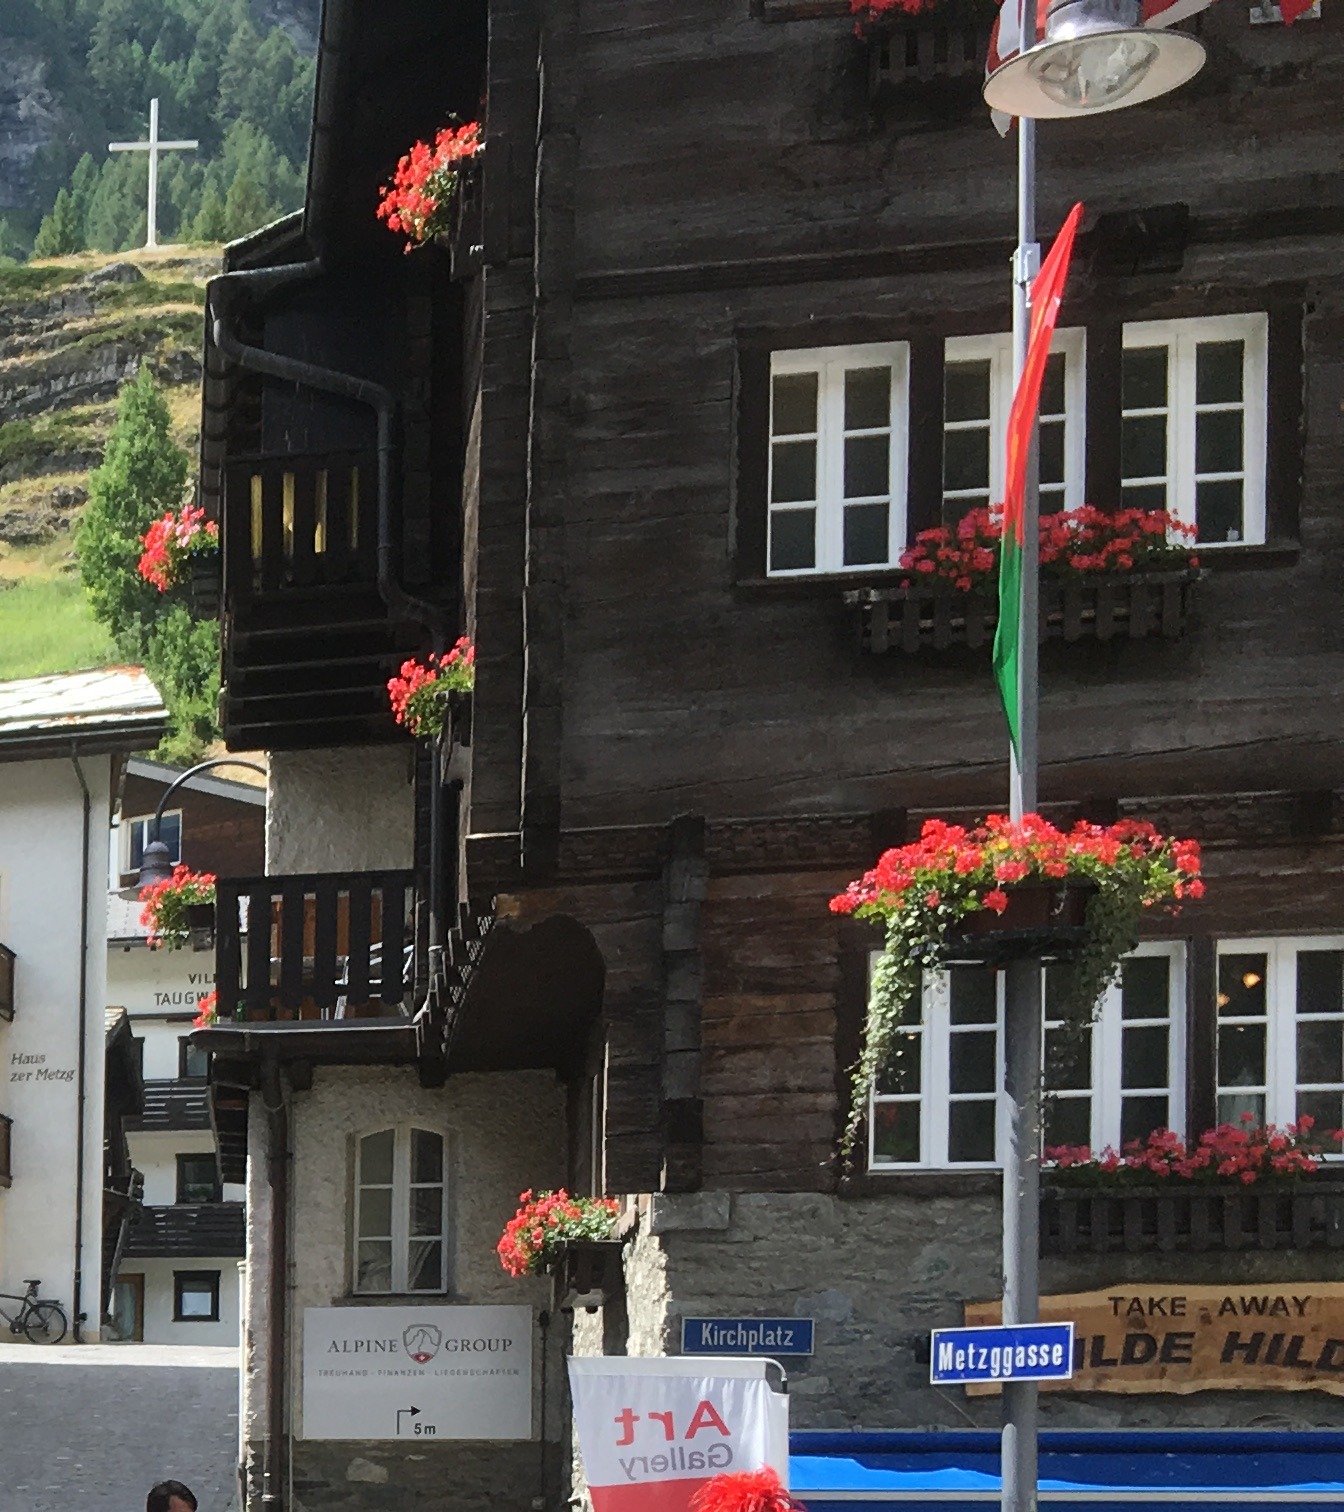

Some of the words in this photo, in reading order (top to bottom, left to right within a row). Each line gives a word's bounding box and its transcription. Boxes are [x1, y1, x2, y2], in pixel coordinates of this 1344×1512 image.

[188, 973, 217, 985] VIL
[11, 1052, 47, 1065] Haus
[10, 1071, 33, 1083] zer
[35, 1068, 76, 1083] Metzg
[1108, 1296, 1187, 1317] TAKE
[1218, 1295, 1312, 1317] AWAY
[701, 1322, 794, 1352] Kirchplatz
[327, 1339, 399, 1353] ALPINE
[445, 1338, 512, 1353] GROUP
[1072, 1331, 1197, 1370] ILDE
[938, 1341, 1064, 1377] Metzggasse
[318, 1369, 368, 1377] TREUHAND
[377, 1368, 425, 1377] FINANZEN
[413, 1422, 422, 1435] 5
[424, 1425, 436, 1435] m
